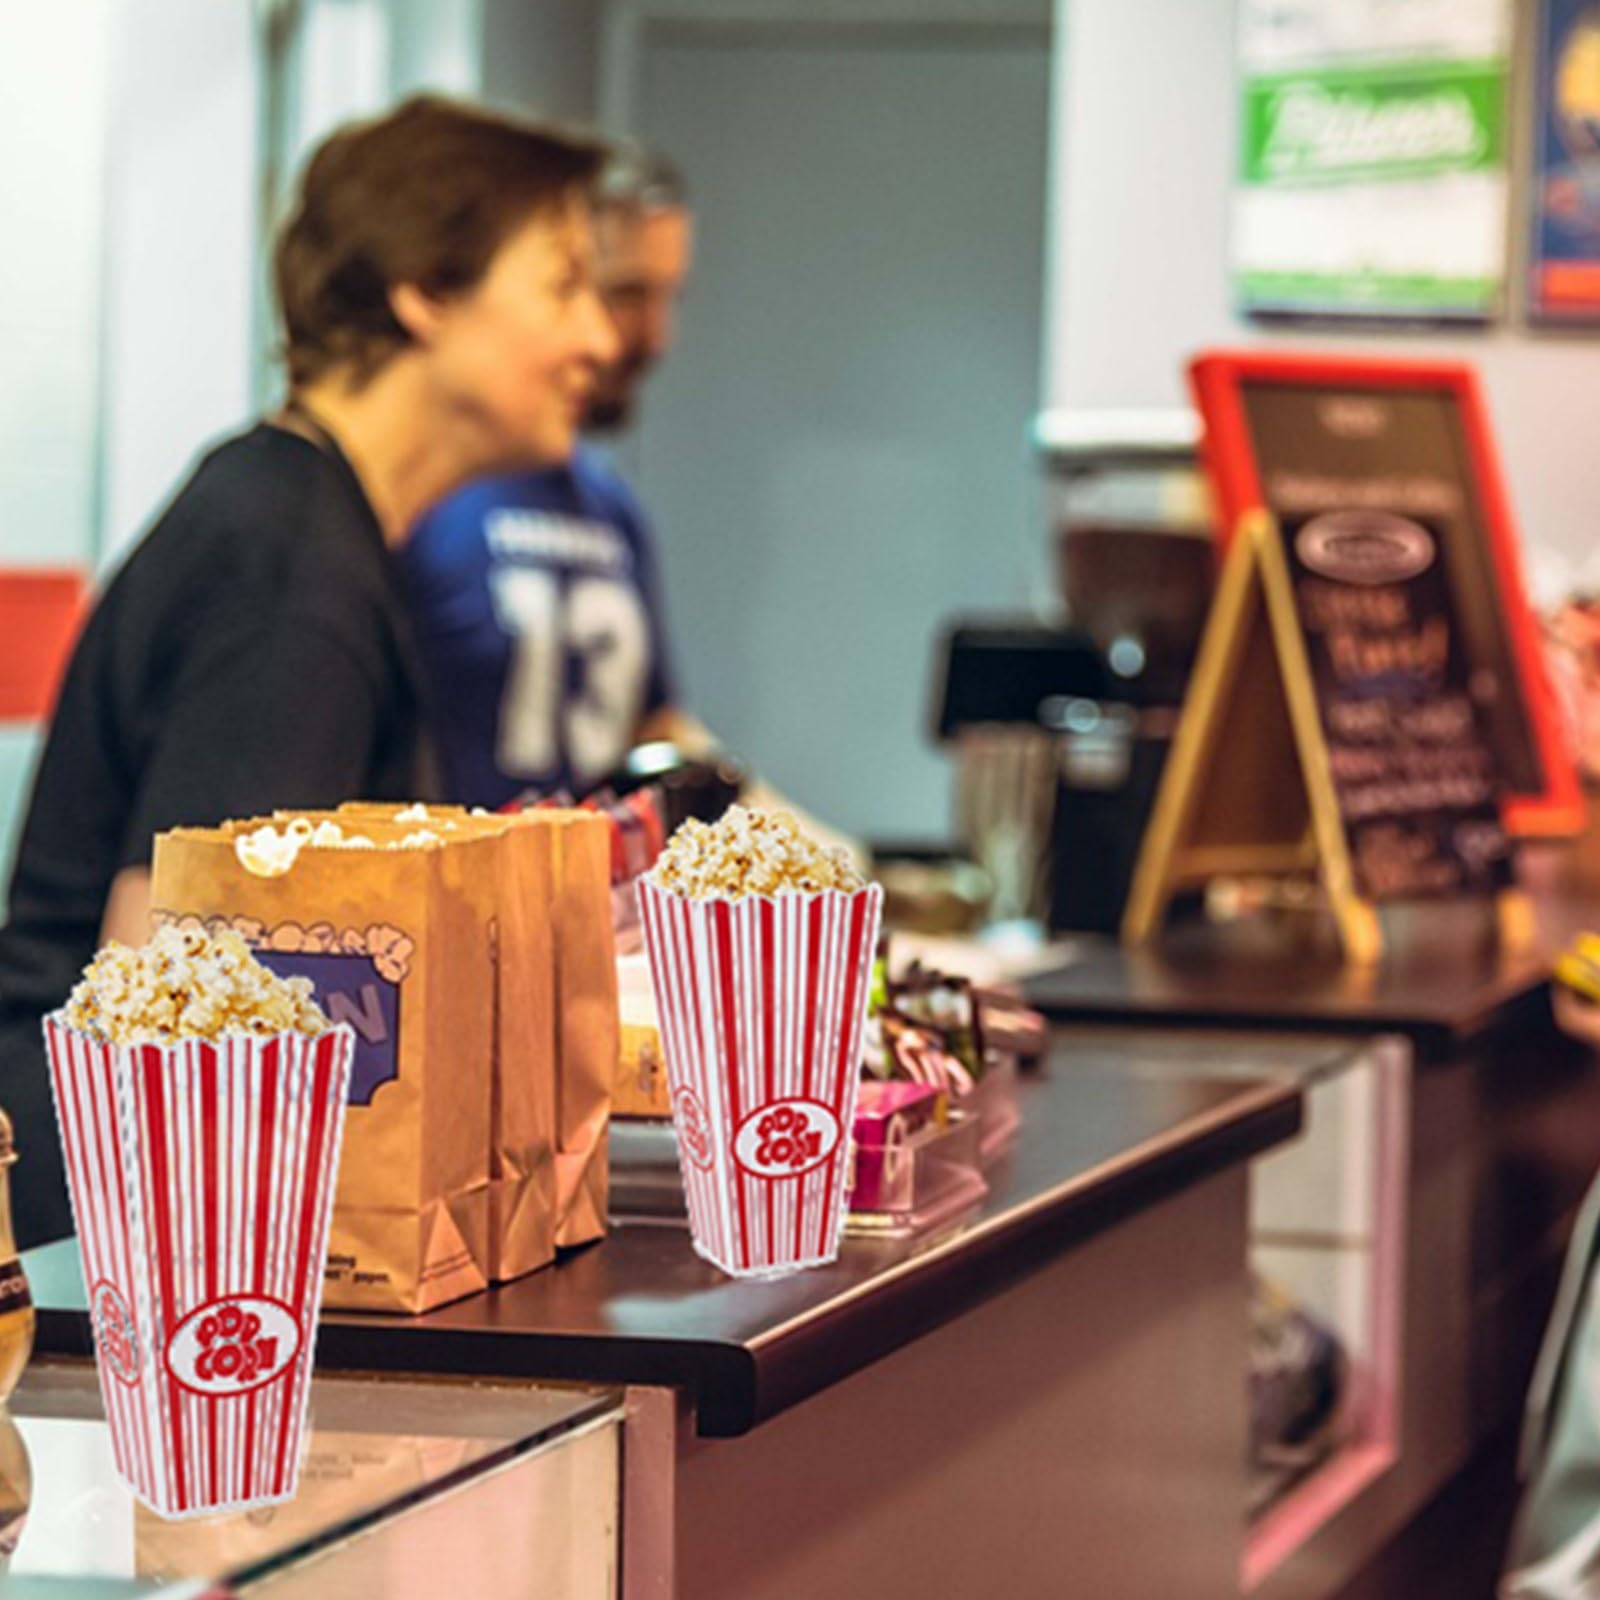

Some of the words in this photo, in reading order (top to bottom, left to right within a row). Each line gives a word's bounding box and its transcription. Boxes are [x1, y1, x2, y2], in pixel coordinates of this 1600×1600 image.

[756, 1106, 808, 1138] POP
[755, 1131, 822, 1167] CORN
[196, 1305, 261, 1346] POP
[195, 1336, 278, 1382] CORN
